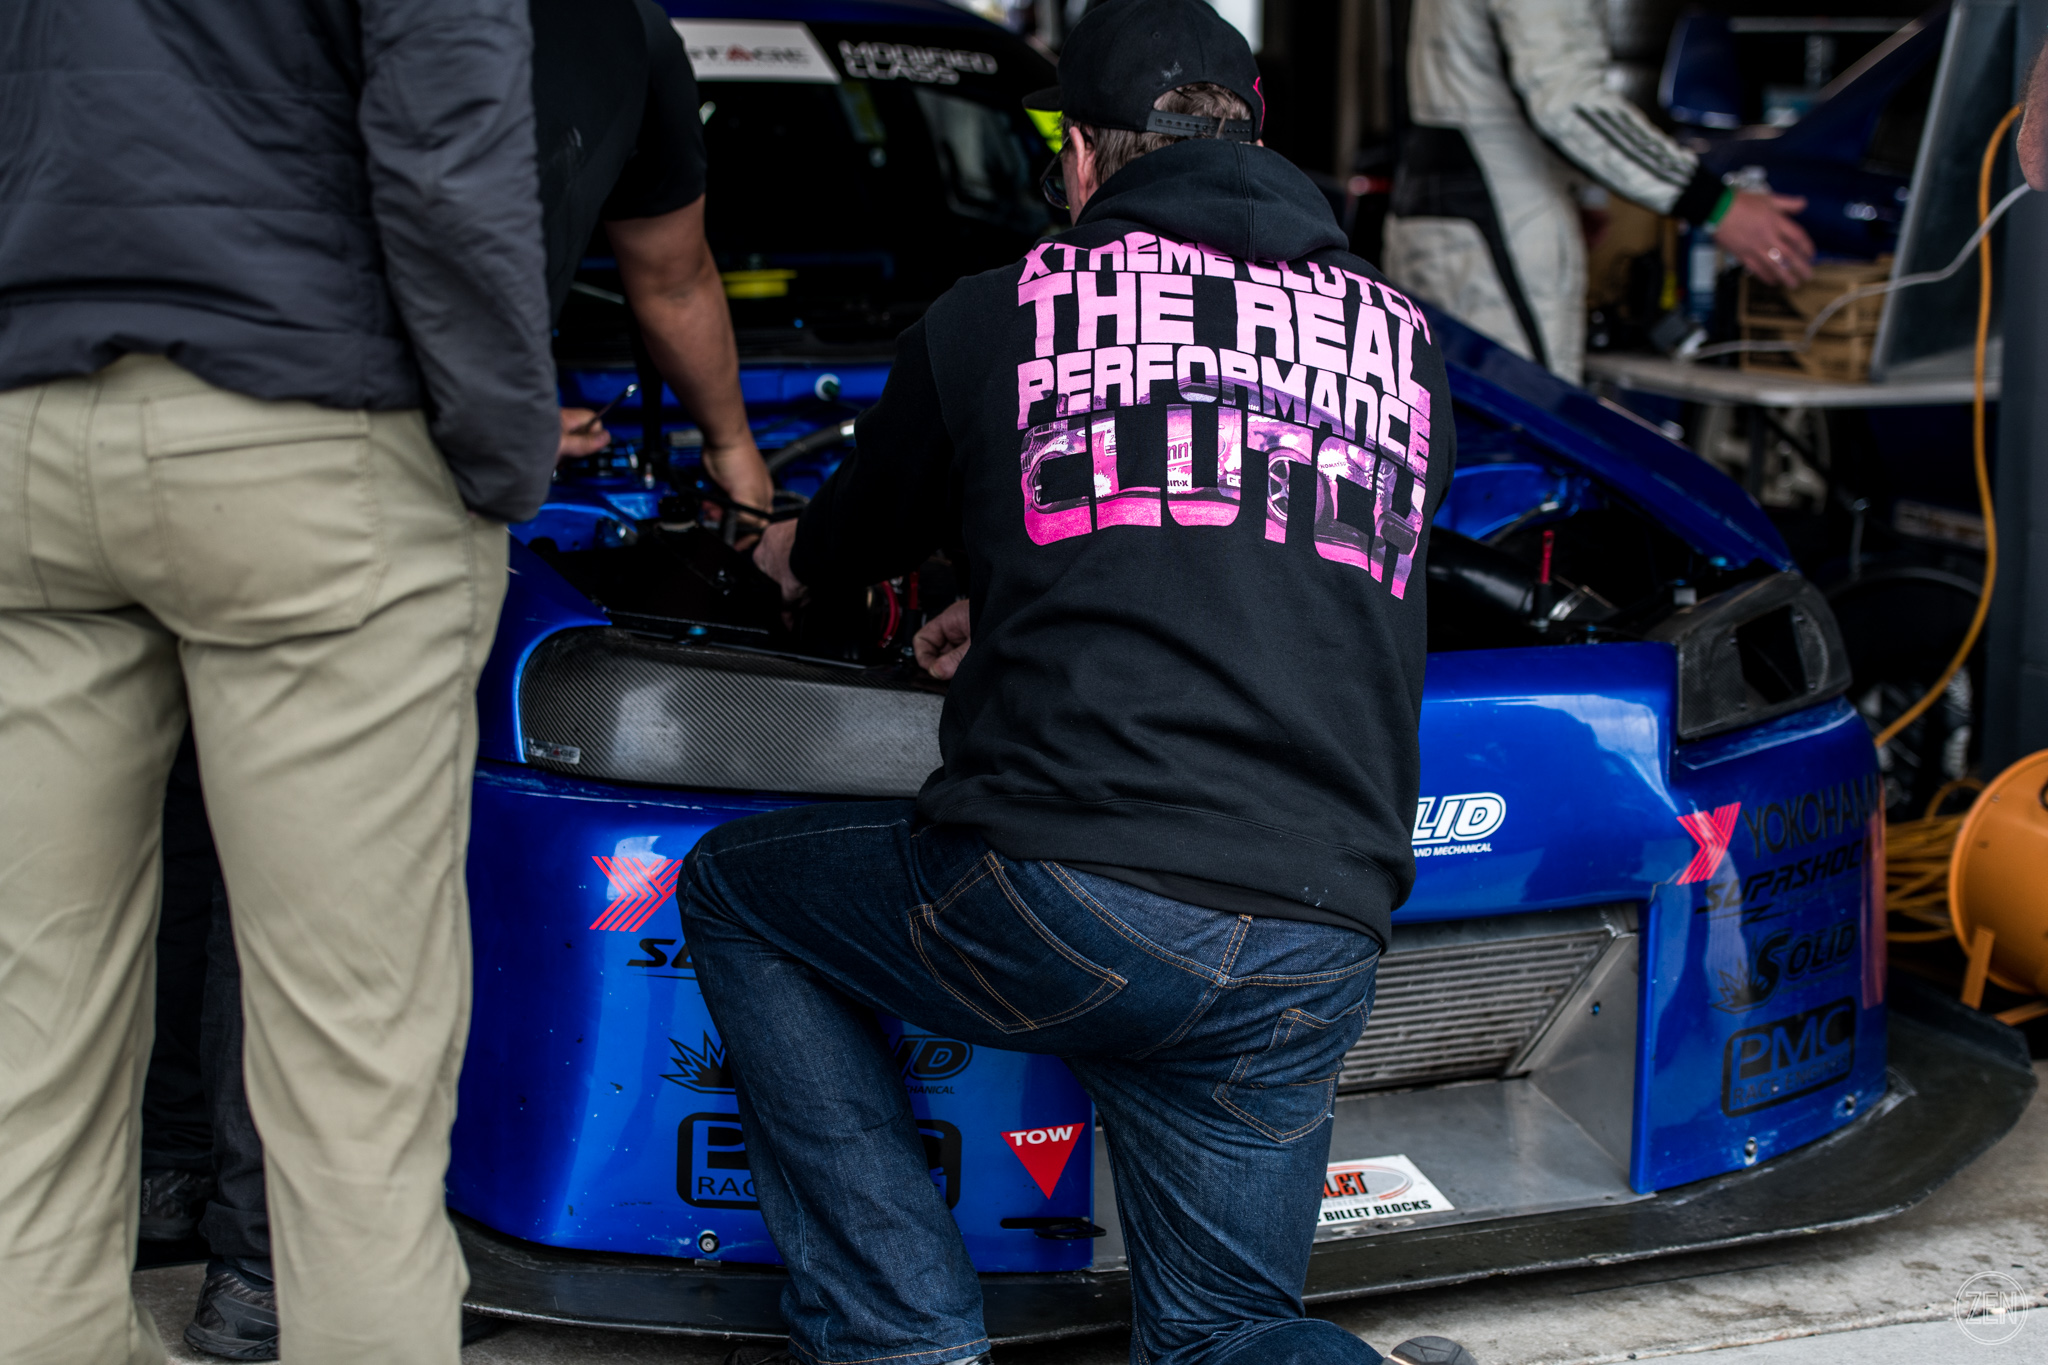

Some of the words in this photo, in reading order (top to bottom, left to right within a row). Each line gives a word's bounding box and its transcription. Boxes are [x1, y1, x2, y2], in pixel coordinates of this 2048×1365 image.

[838, 40, 998, 75] MODIFIED
[844, 56, 960, 85] CLASS
[1017, 231, 1236, 286] XTREME
[1017, 270, 1195, 358] THE
[1233, 279, 1431, 410] REAL
[1017, 343, 1431, 481] PERFORMANCE
[1019, 403, 1427, 600] CLUTCH
[1411, 791, 1507, 846] LID
[1433, 842, 1493, 857] MECHANICAL
[1752, 919, 1857, 1002] SOLID
[1733, 1004, 1852, 1082] PMC
[1009, 1126, 1074, 1147] TOW
[698, 1176, 758, 1198] RAC
[1324, 1206, 1371, 1222] BILLET
[1373, 1199, 1433, 1216] BLOCKS
